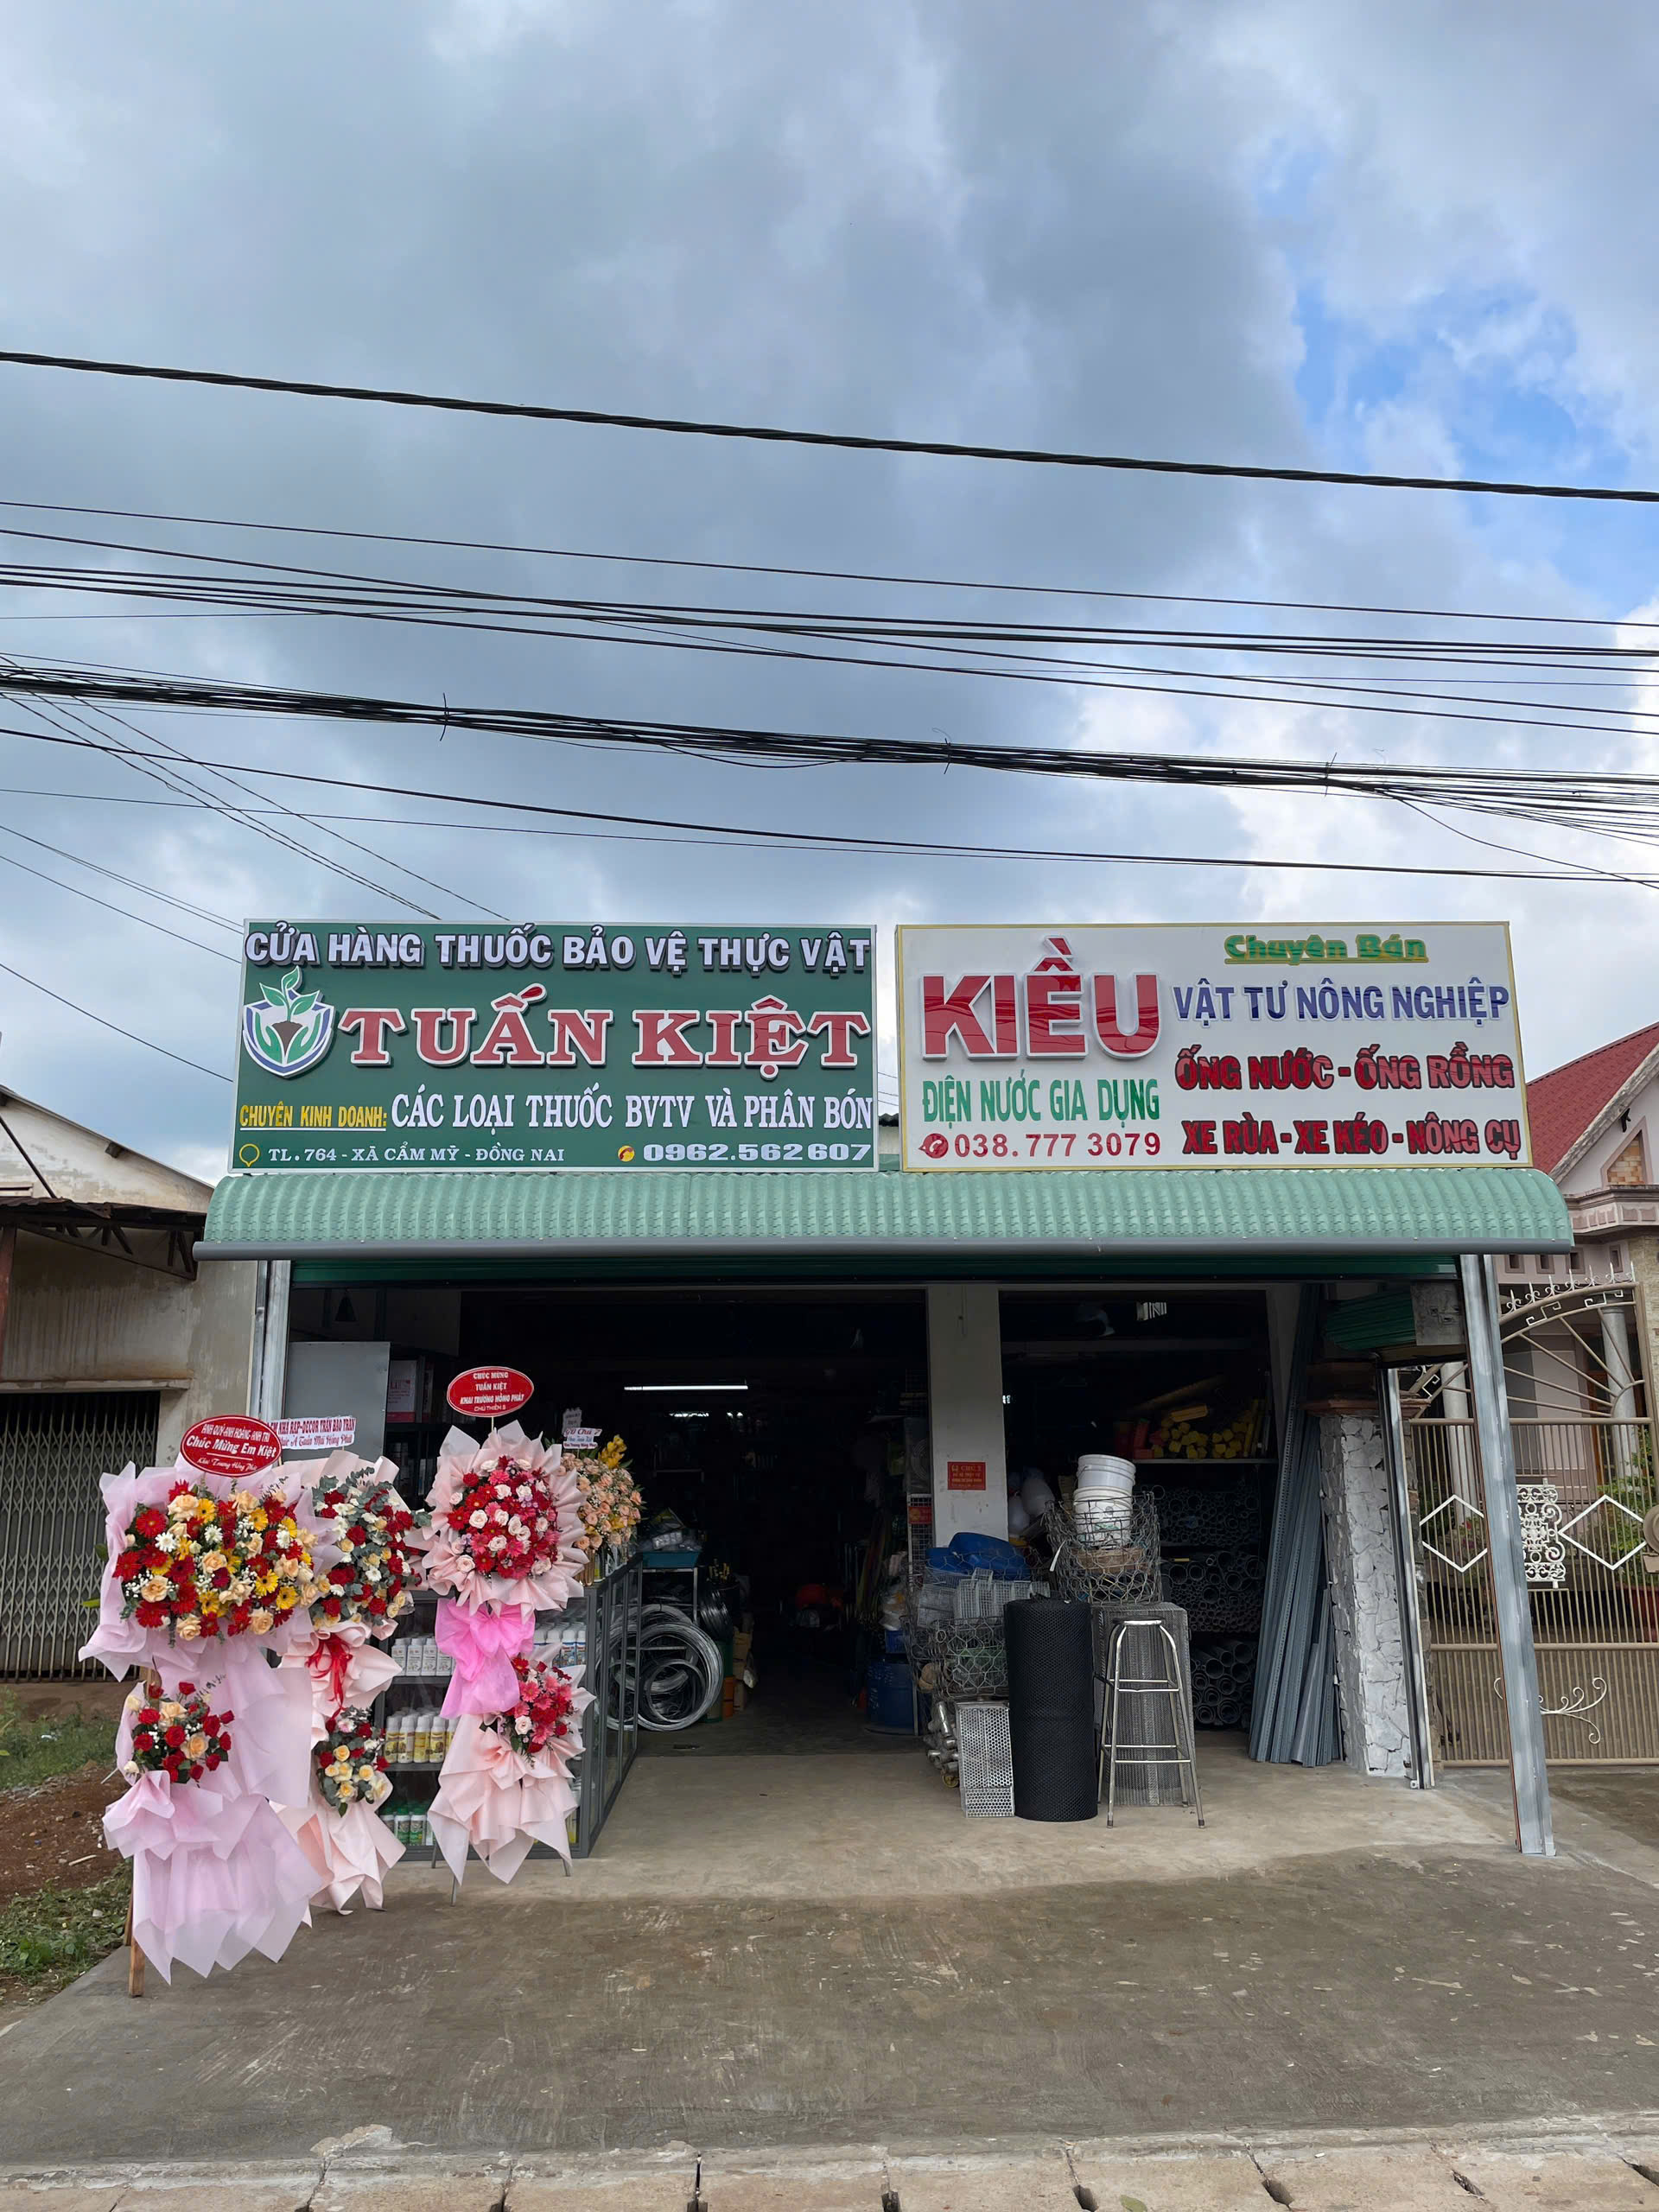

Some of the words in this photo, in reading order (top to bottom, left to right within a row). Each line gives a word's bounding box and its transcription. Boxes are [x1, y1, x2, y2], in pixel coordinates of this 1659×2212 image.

[245, 920, 319, 965] CỬA
[327, 926, 424, 967] HÀNG
[435, 923, 554, 968] THUỐC
[563, 925, 635, 969] BẢO
[645, 930, 687, 976] VỆ
[698, 932, 790, 976] THỰC
[800, 931, 870, 976] VẬT
[1224, 934, 1347, 965] Chuyên
[1355, 933, 1427, 960] Bán
[920, 935, 1160, 1060] KIỀU
[1173, 978, 1235, 1027] VẬT
[1243, 980, 1288, 1020] TƯ
[1295, 978, 1385, 1020] NÔNG
[1392, 976, 1510, 1027] NGHIỆP
[338, 982, 613, 1067] TUẤN
[632, 995, 872, 1080] KIỆT
[1174, 1044, 1242, 1090] ỐNG
[1248, 1047, 1334, 1090] NƯỚC
[1354, 1044, 1422, 1090] ỐNG
[1427, 1041, 1515, 1089] RỒNG
[239, 1100, 292, 1127] CHUYÊN
[300, 1106, 332, 1127] KINH
[338, 1106, 387, 1127] DOANH:
[391, 1084, 444, 1128] CÁC
[452, 1094, 515, 1135] LOẠI
[525, 1082, 613, 1128] THUỐC
[625, 1095, 695, 1128] BVTV
[705, 1087, 737, 1128] VÀ
[744, 1089, 815, 1128] PHÂN
[823, 1088, 874, 1129] BÓN
[922, 1075, 971, 1128] ĐIỆN
[980, 1069, 1041, 1122] NƯỚC
[1050, 1080, 1088, 1122] GIA
[1097, 1079, 1160, 1128] DỤNG
[351, 1146, 379, 1160] XÃ
[384, 1141, 425, 1161] CẨM
[430, 1144, 458, 1160] MỸ
[475, 1142, 525, 1161] ĐỒNG
[531, 1148, 564, 1161] NAI
[1087, 1132, 1160, 1156] 3079
[1181, 1121, 1217, 1154] XE
[1223, 1112, 1279, 1154] RÙA
[1293, 1121, 1330, 1154] XE
[1332, 1112, 1389, 1154] KÉO
[1406, 1112, 1479, 1154] NÔNG
[1484, 1120, 1522, 1160] CỤ
[186, 1435, 212, 1449] Chúc
[213, 1439, 239, 1455] Mừng
[240, 1442, 257, 1455] Em
[257, 1445, 276, 1459] Kiệt
